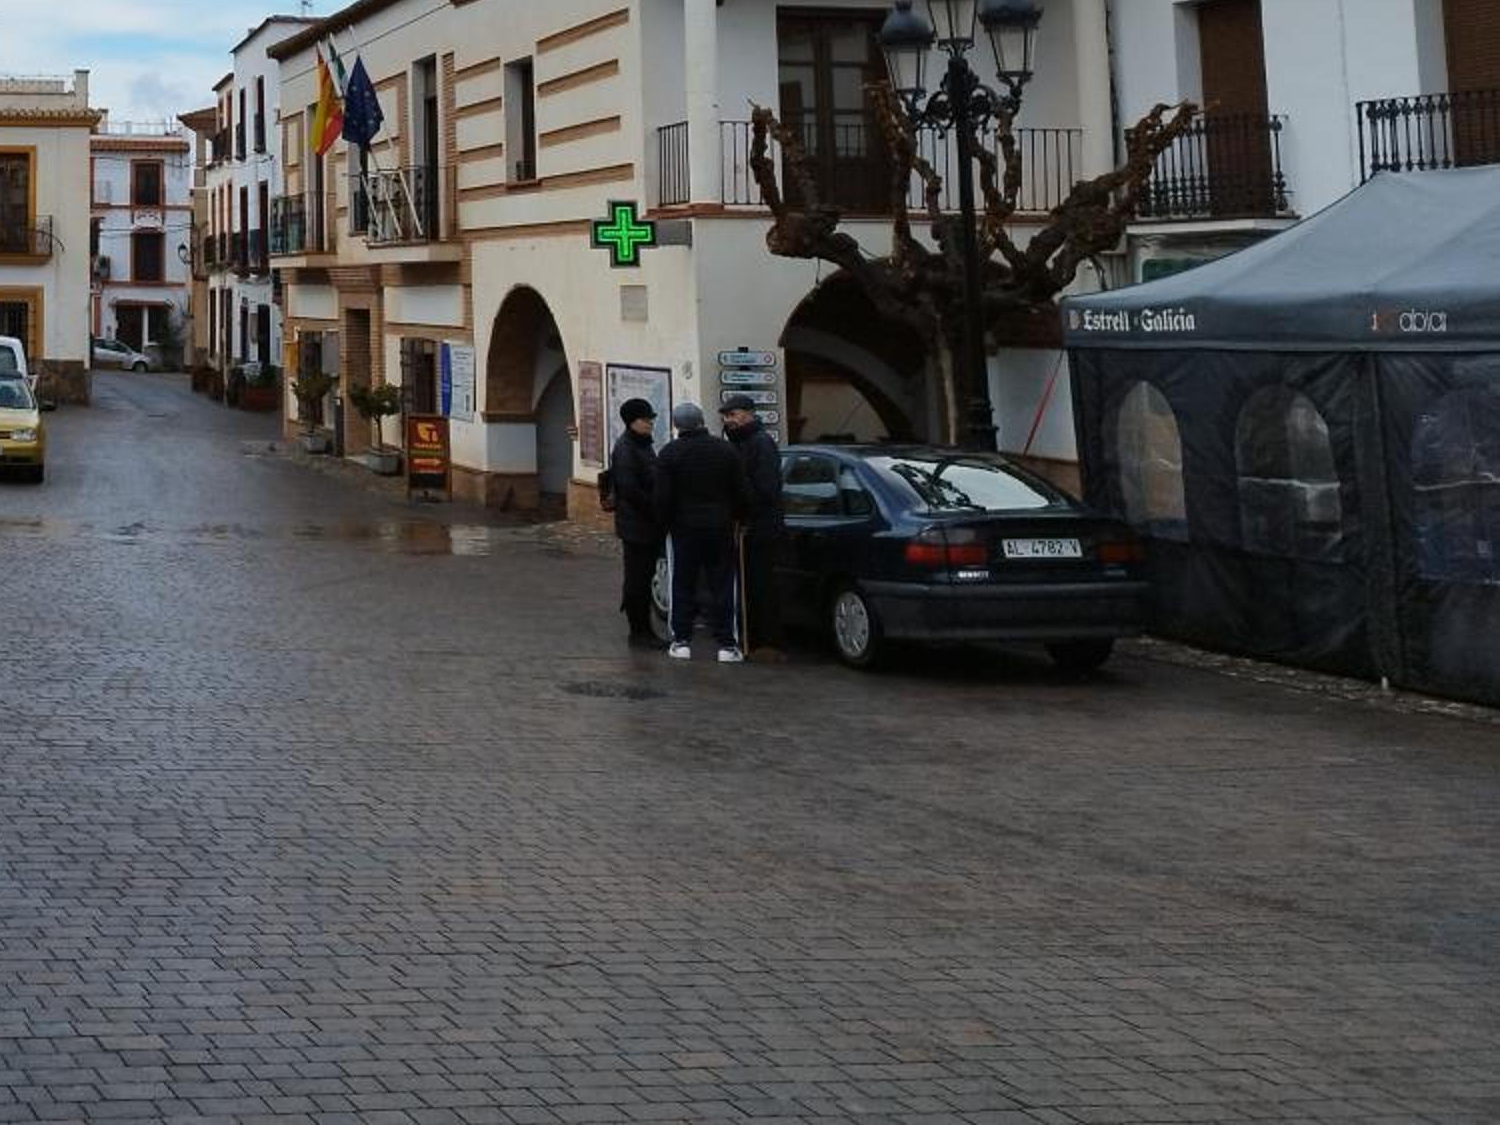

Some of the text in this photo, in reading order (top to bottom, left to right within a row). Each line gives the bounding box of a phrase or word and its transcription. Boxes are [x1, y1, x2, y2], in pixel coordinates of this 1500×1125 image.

[1083, 307, 1196, 332] Estrell Galicia
[1007, 540, 1024, 555] AL
[1031, 540, 1064, 555] 4782
